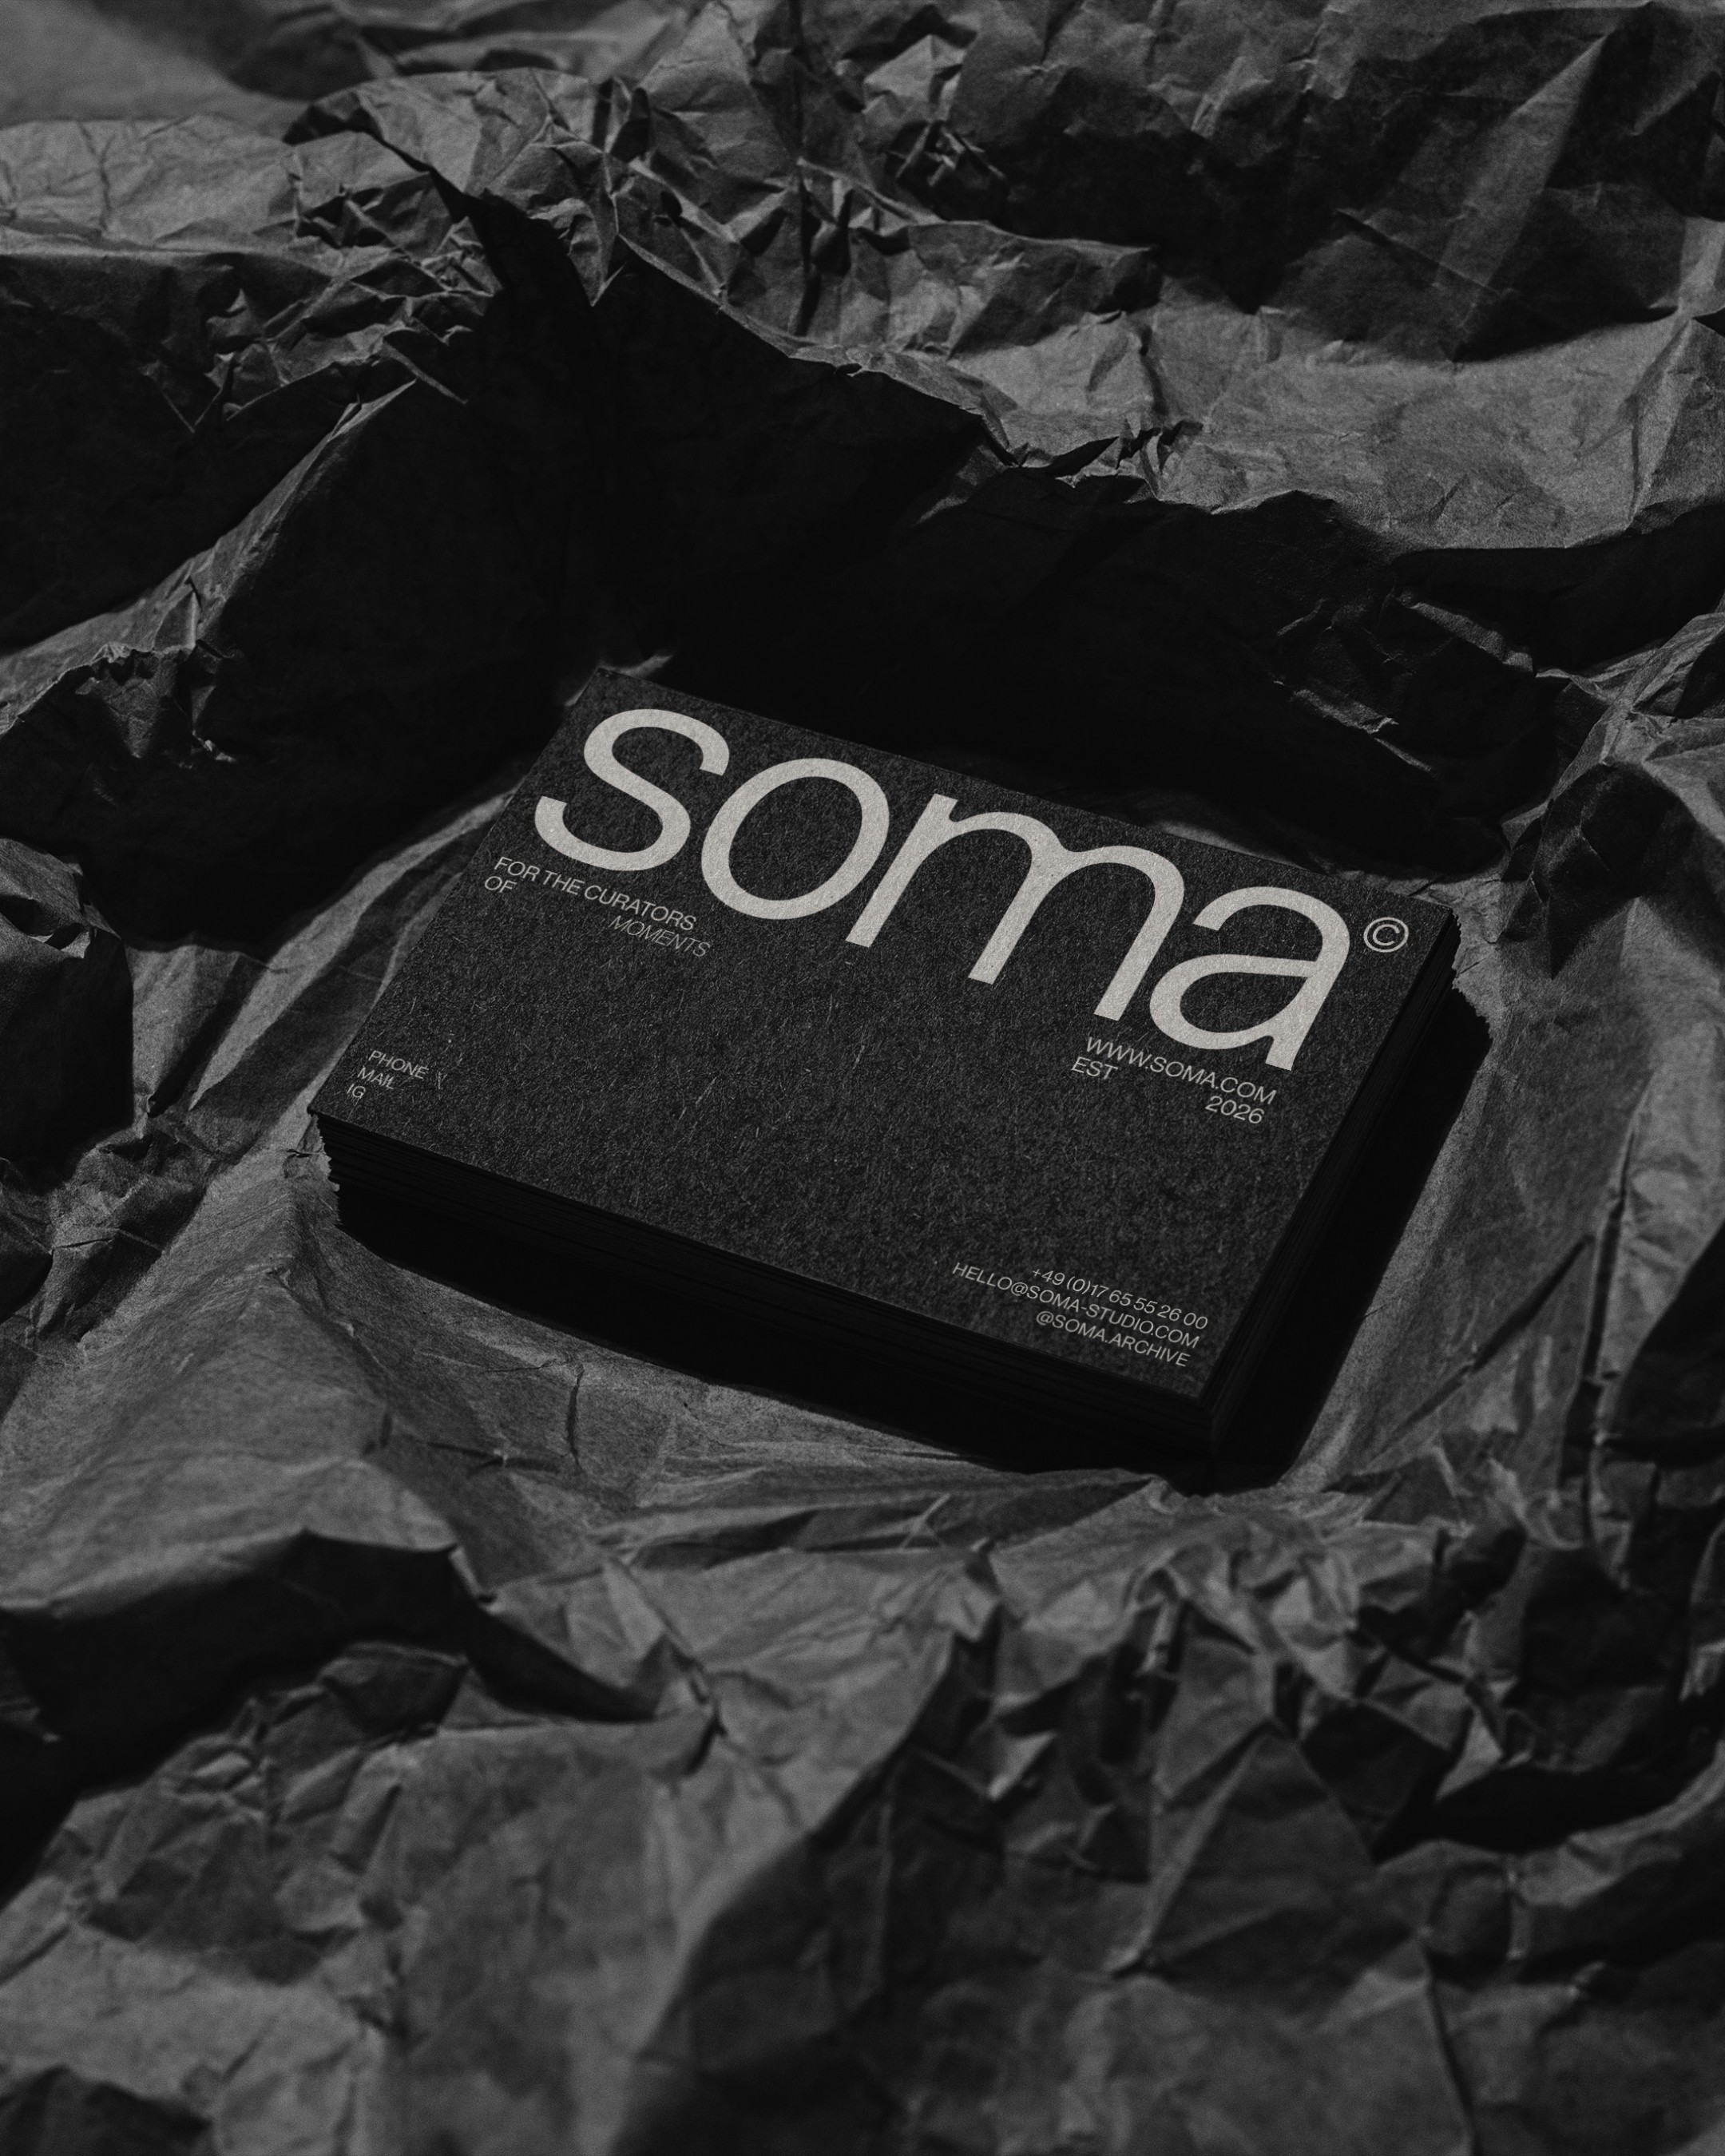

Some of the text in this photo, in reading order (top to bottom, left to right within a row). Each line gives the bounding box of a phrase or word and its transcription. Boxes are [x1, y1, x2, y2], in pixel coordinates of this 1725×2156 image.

[484, 876, 711, 957] OF MOMENTS
[494, 856, 697, 930] FOR THE CURATORS
[346, 1083, 367, 1099] IG
[357, 1066, 395, 1091] MAIL
[367, 1049, 430, 1080] PHONE
[1071, 1056, 1265, 1124] EST 2026
[1086, 1036, 1277, 1105] WWW.SOMA.COM
[952, 1262, 1200, 1349] HELLO@SOMA-STUDIO.COM
[1032, 1268, 1208, 1330] +49 (0)17 65 55 26 00
[1036, 1310, 1192, 1368] @SOMA.ARCHIVE
